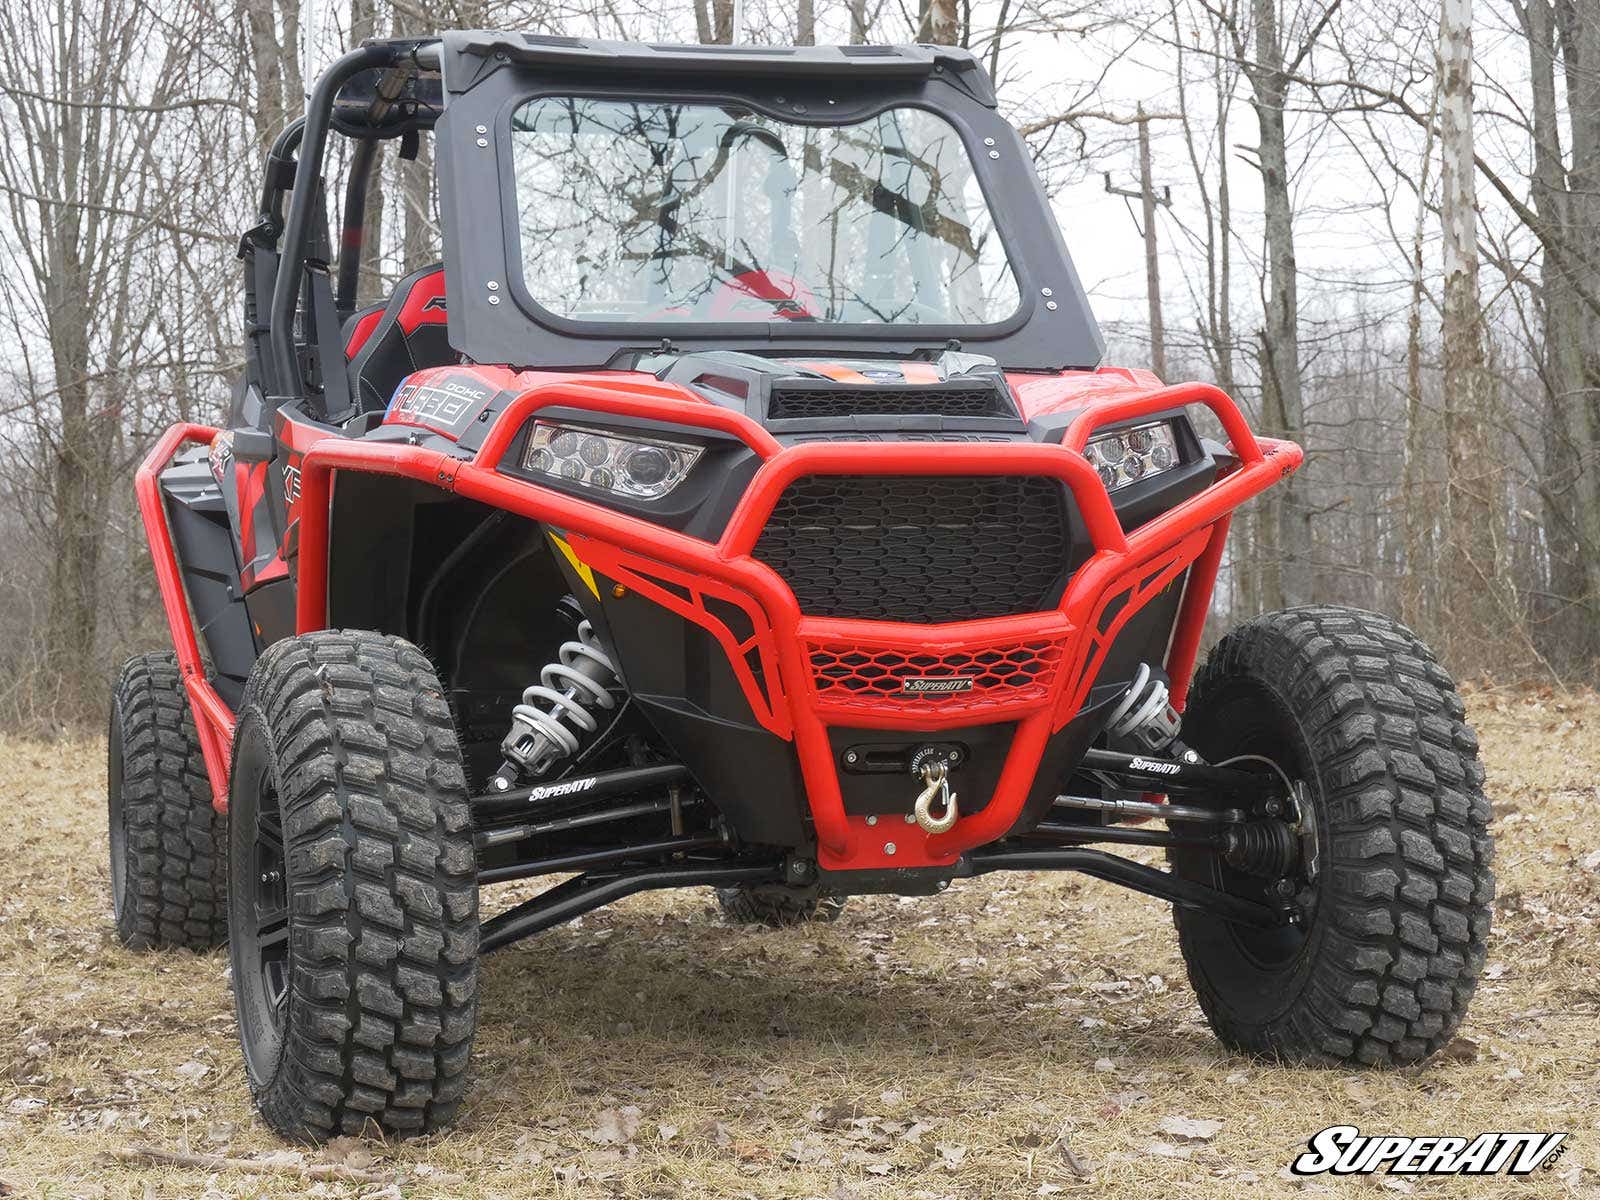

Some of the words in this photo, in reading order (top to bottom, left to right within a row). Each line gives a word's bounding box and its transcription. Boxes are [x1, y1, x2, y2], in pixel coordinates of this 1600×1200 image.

[446, 383, 486, 399] DOHC
[910, 680, 967, 691] SUPERATV
[1129, 757, 1181, 775] SUPERATV
[528, 777, 597, 802] SUPERATV
